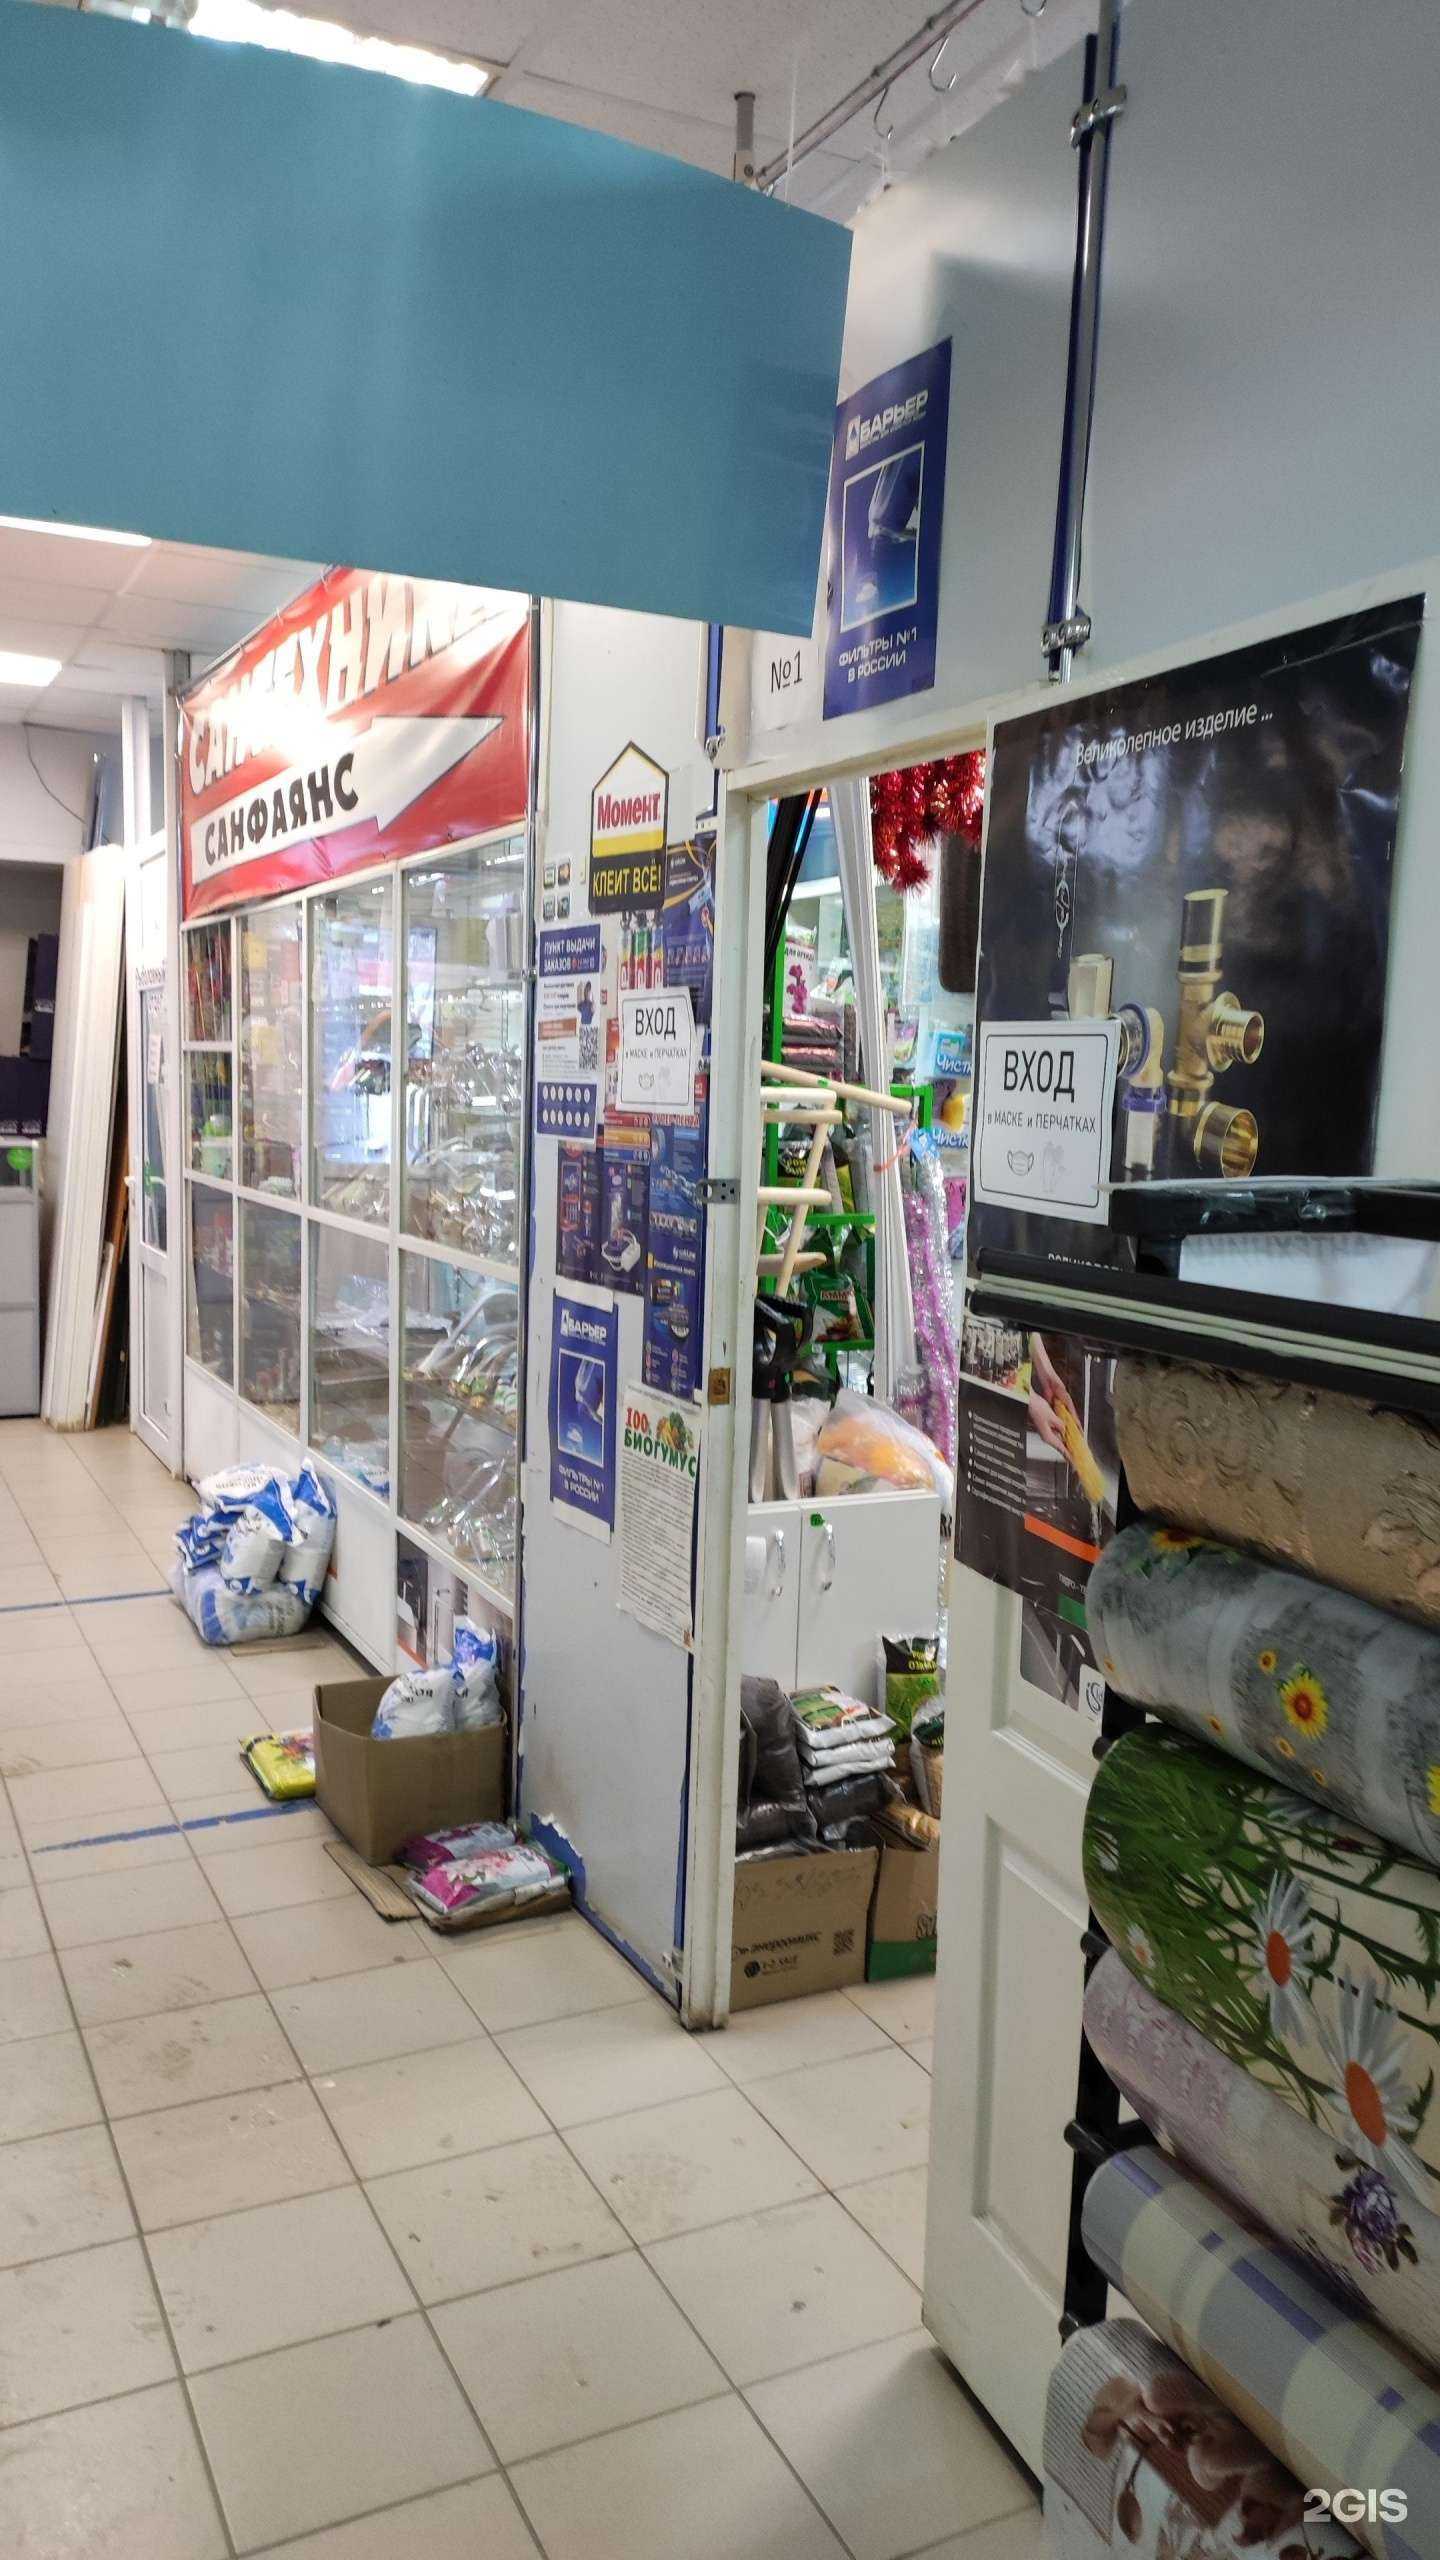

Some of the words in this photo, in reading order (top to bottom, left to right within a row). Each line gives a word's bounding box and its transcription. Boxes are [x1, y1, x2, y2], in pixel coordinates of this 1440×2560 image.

[859, 389, 929, 442] БАРЬЕР
[838, 634, 893, 668] ФИЛЬТРЫ
[895, 625, 918, 652] №1
[190, 568, 520, 795] САНХНИ
[770, 650, 804, 694] №1
[847, 662, 856, 684] В
[856, 650, 906, 681] РОССИИ
[1074, 722, 1181, 767] Великолепное
[1184, 703, 1257, 743] изделие
[204, 752, 360, 866] САНФАЯНС
[597, 792, 661, 831] Момент
[592, 868, 630, 896] КЛЕИТ
[632, 857, 662, 893] ВСЁ!
[543, 957, 572, 974] ЗАКАЗОВ
[544, 938, 565, 956] ПУНКТ
[565, 936, 597, 955] ВЫДАЧИ
[634, 1006, 677, 1041] ВХОД
[629, 1047, 649, 1059] МАСКЕ
[654, 1047, 688, 1059] ПЕРЧАТКАХ
[1003, 1050, 1075, 1103] ВХОД
[987, 1113, 993, 1125] в
[994, 1109, 1023, 1128] МАСКЕ
[1026, 1115, 1034, 1127] и
[1035, 1111, 1097, 1134] ПЕРЧАТКАХ
[568, 1320, 608, 1340] БАРЬЕР
[623, 1427, 698, 1479] БИОГУМУС
[558, 1463, 593, 1487] ФИЛЬТРЫ
[569, 1482, 600, 1504] РОССИИ
